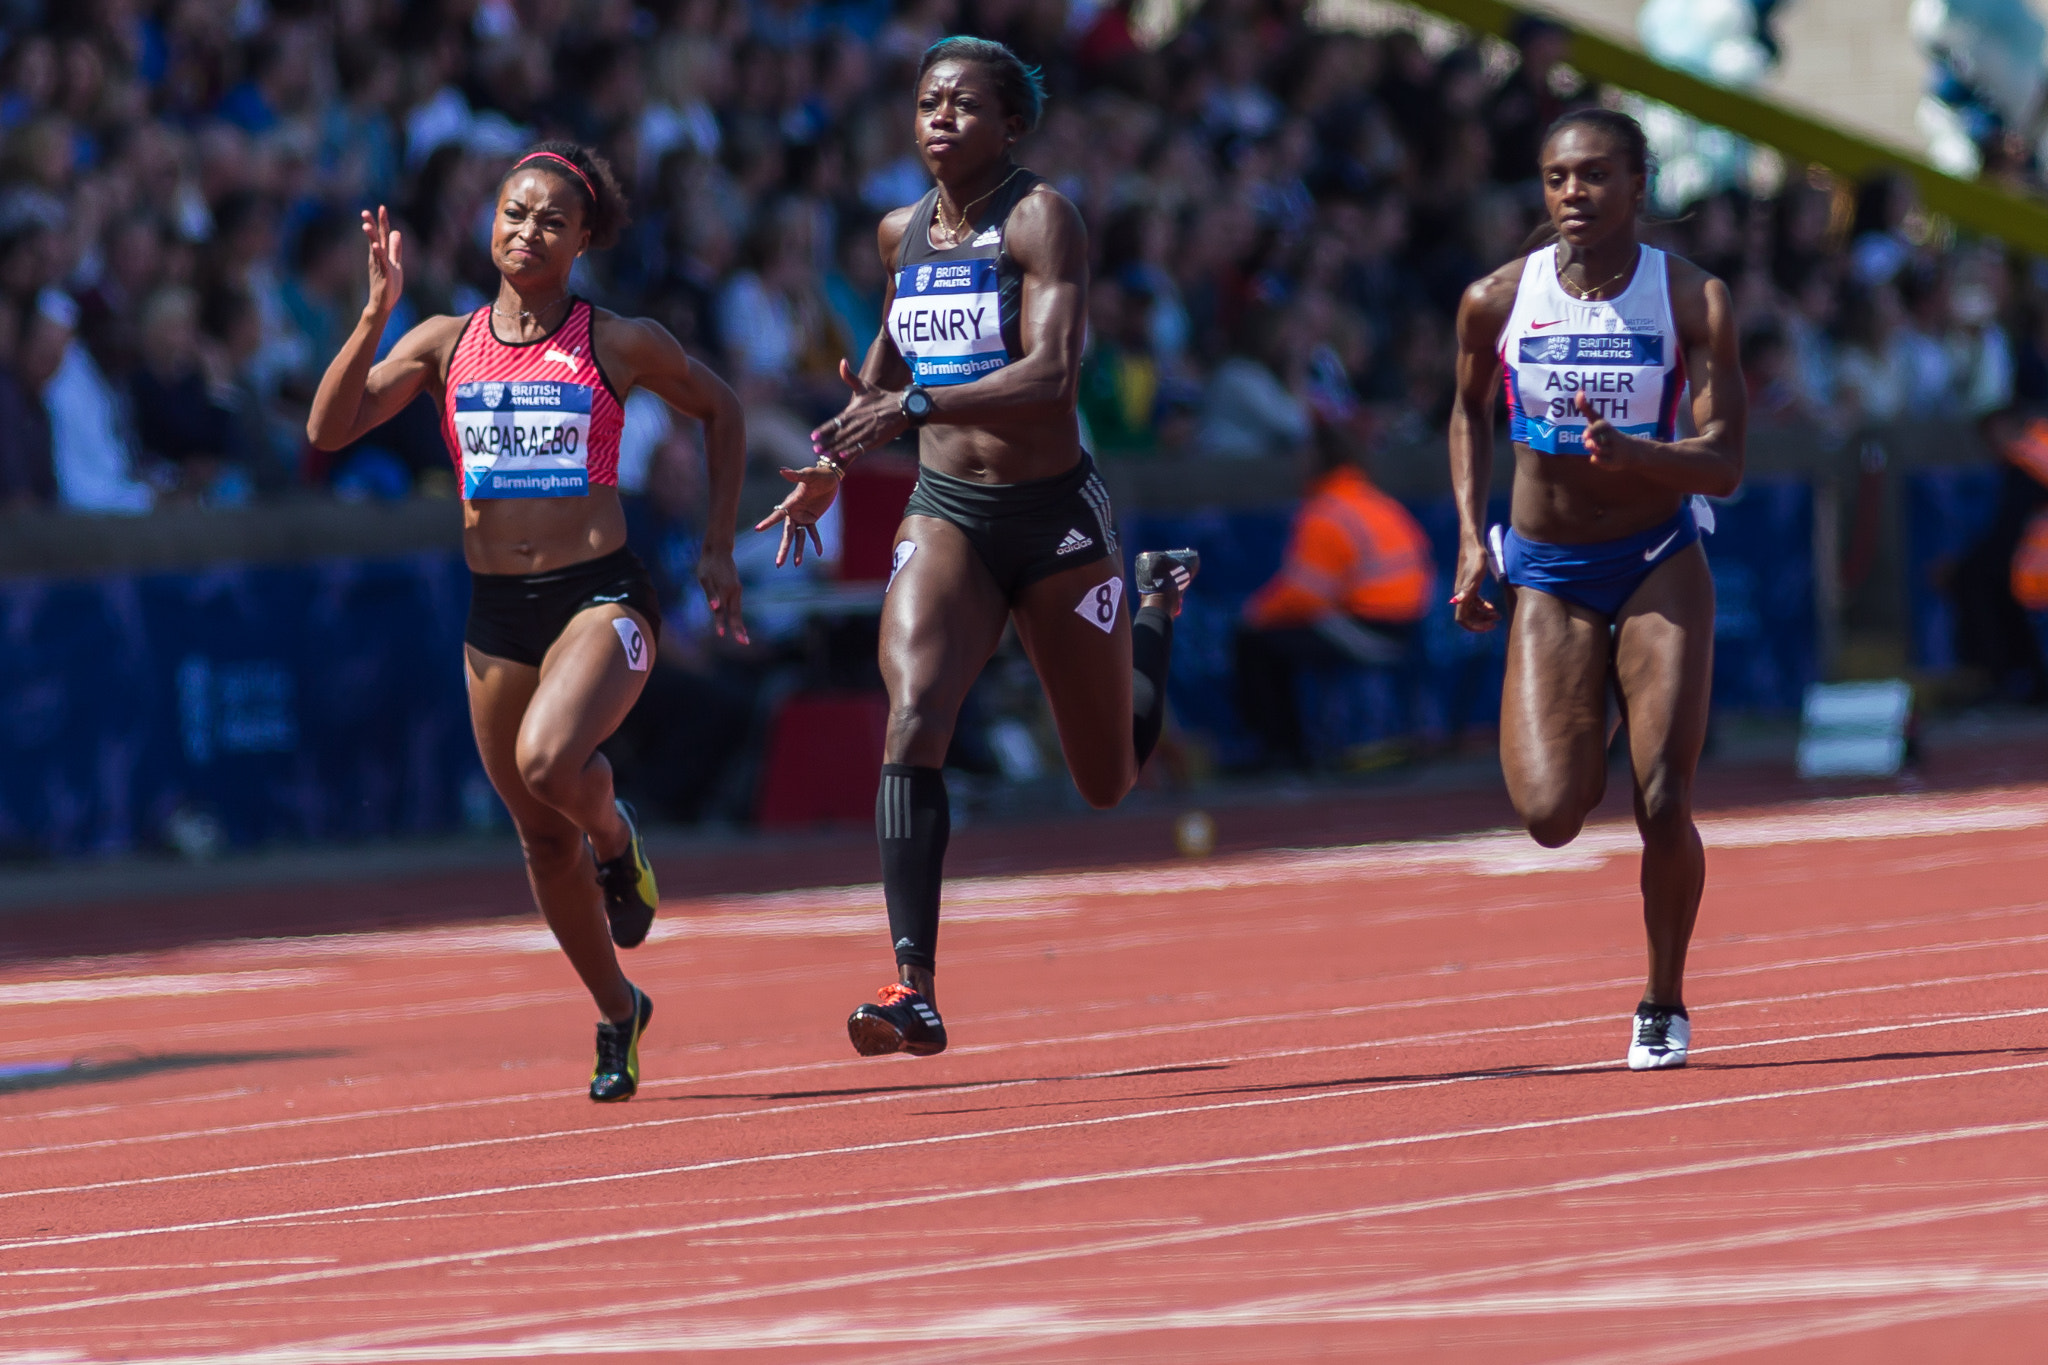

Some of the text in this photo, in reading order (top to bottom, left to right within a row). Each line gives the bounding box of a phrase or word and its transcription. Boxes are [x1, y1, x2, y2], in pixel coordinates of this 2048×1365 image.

[935, 265, 971, 278] BRITISH
[933, 277, 972, 288] ATHLETICS
[897, 306, 985, 343] HENRY
[1577, 337, 1632, 348] BRITISH
[1576, 349, 1633, 359] ATHLETICS
[918, 357, 1005, 376] Birmingham
[511, 384, 561, 396] BRITISH
[1545, 370, 1635, 393] ASHER
[510, 396, 561, 406] ATHLETICS
[465, 426, 579, 457] OKPARAEBO
[492, 474, 583, 491] Birmingham
[1056, 538, 1093, 555] adidas
[1096, 584, 1113, 623] 8
[628, 630, 643, 666] 9
